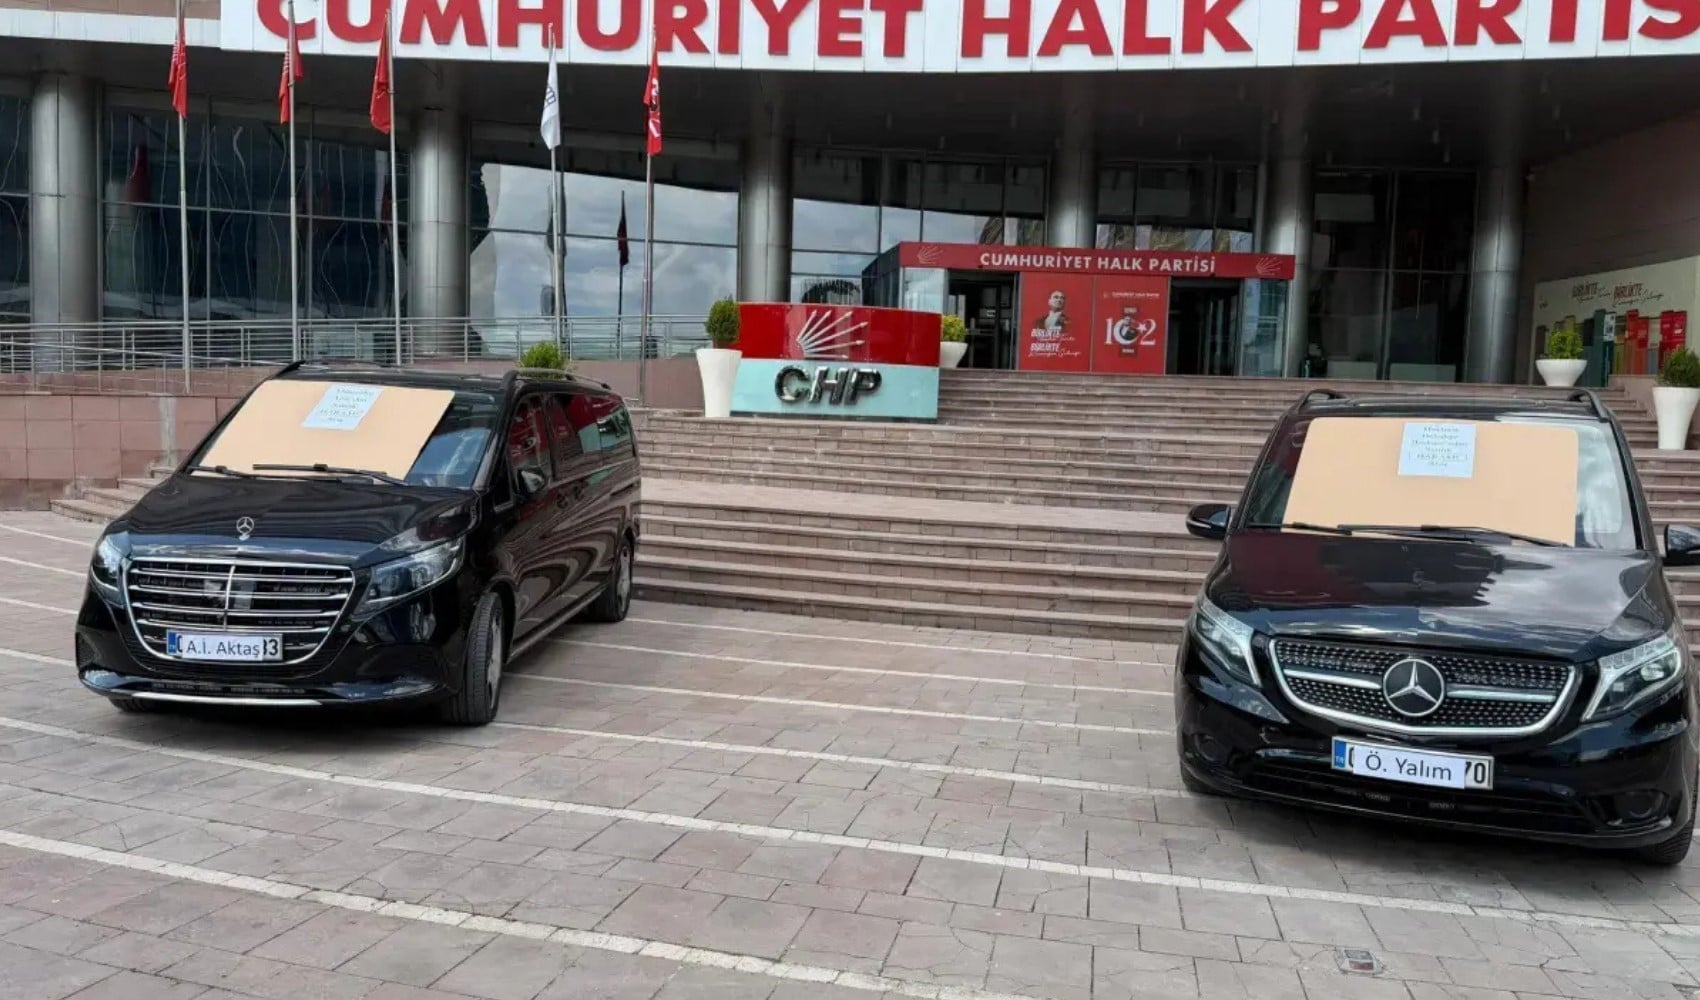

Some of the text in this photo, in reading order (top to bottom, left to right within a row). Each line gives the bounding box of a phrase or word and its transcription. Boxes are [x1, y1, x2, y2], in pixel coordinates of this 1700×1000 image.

[961, 0, 1254, 58] HALK
[980, 251, 1217, 273] CUMHURİYET HALK PARTİSİ
[775, 365, 883, 406] CHP
[216, 642, 261, 658] Aktaş
[1365, 750, 1388, 773] Ö.
[1395, 757, 1451, 781] Yalım
